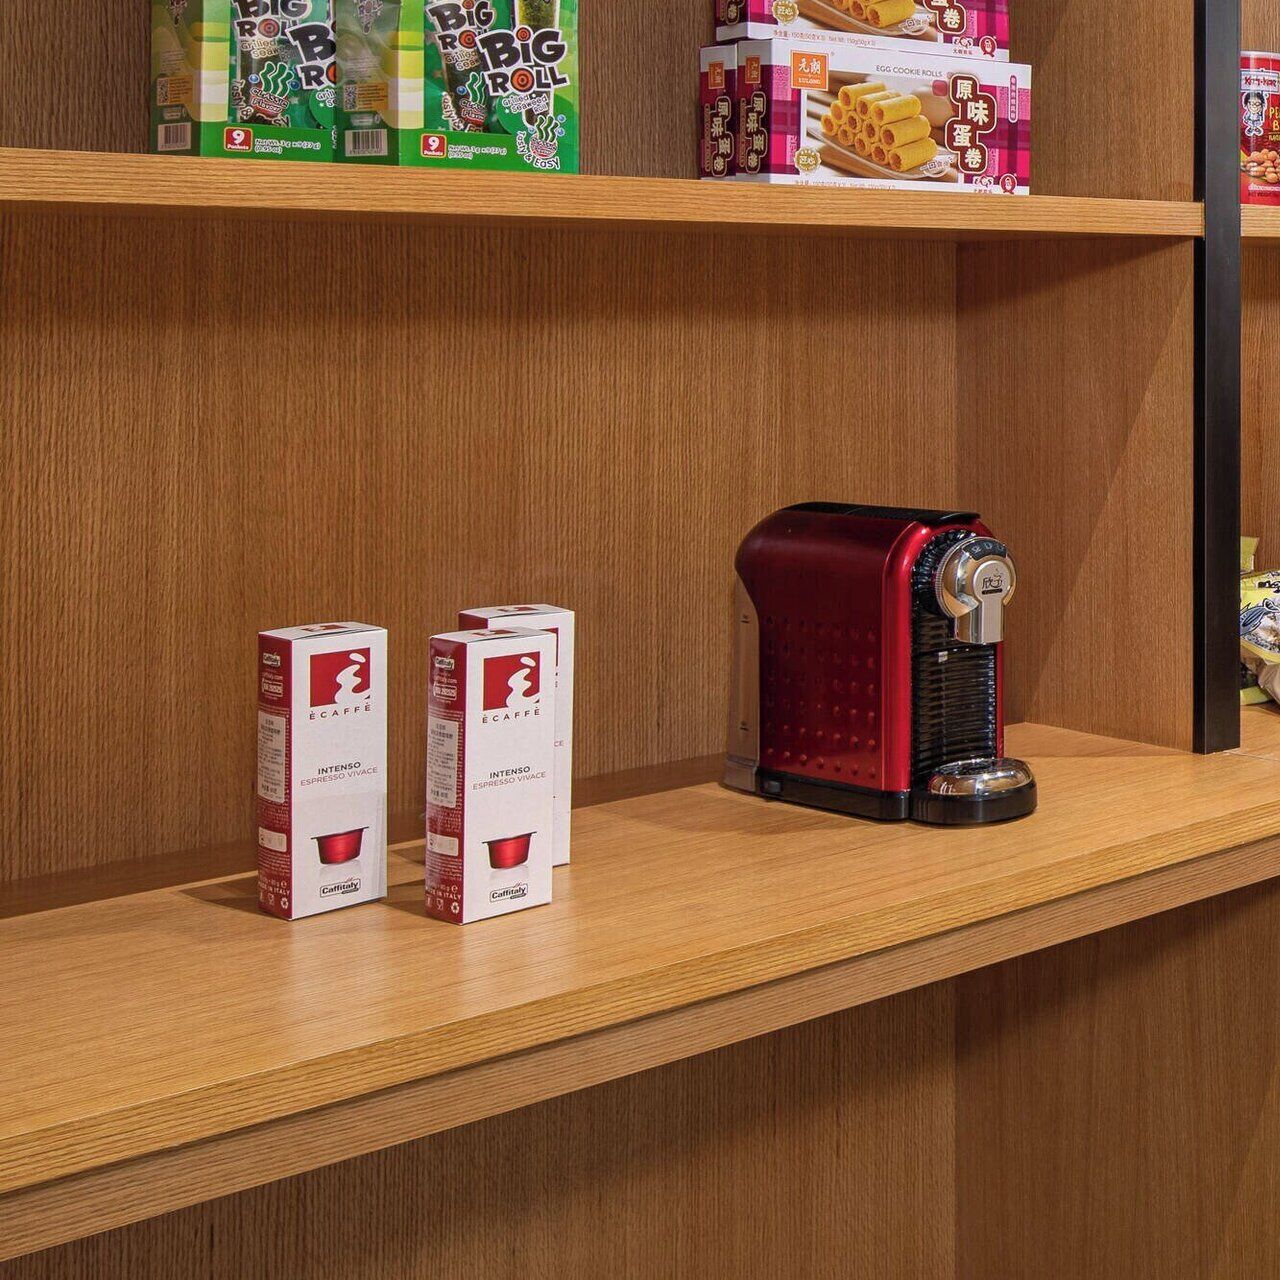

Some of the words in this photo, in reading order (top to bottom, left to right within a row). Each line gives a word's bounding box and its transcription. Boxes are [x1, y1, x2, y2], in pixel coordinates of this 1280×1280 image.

[876, 65, 892, 74] EGG
[893, 67, 921, 76] COOKIE
[922, 69, 942, 78] ROLLS
[489, 67, 568, 94] ROLL
[503, 94, 530, 106] Grilled
[511, 95, 549, 113] Seaweed
[953, 79, 989, 169] 原味蛋卷
[231, 130, 245, 144] 9
[428, 136, 440, 150] 9
[318, 761, 361, 775] INTENSO
[489, 766, 531, 779] INTENSO
[300, 772, 345, 787] ESPRESSO
[347, 766, 378, 778] VIVACE
[472, 777, 515, 791] ESPRESSO
[517, 771, 547, 782] VIVACE
[275, 887, 290, 896] ITALY
[321, 880, 359, 895] Caffitaly
[491, 885, 526, 900] Caffitaly
[443, 892, 462, 900] ITALY
